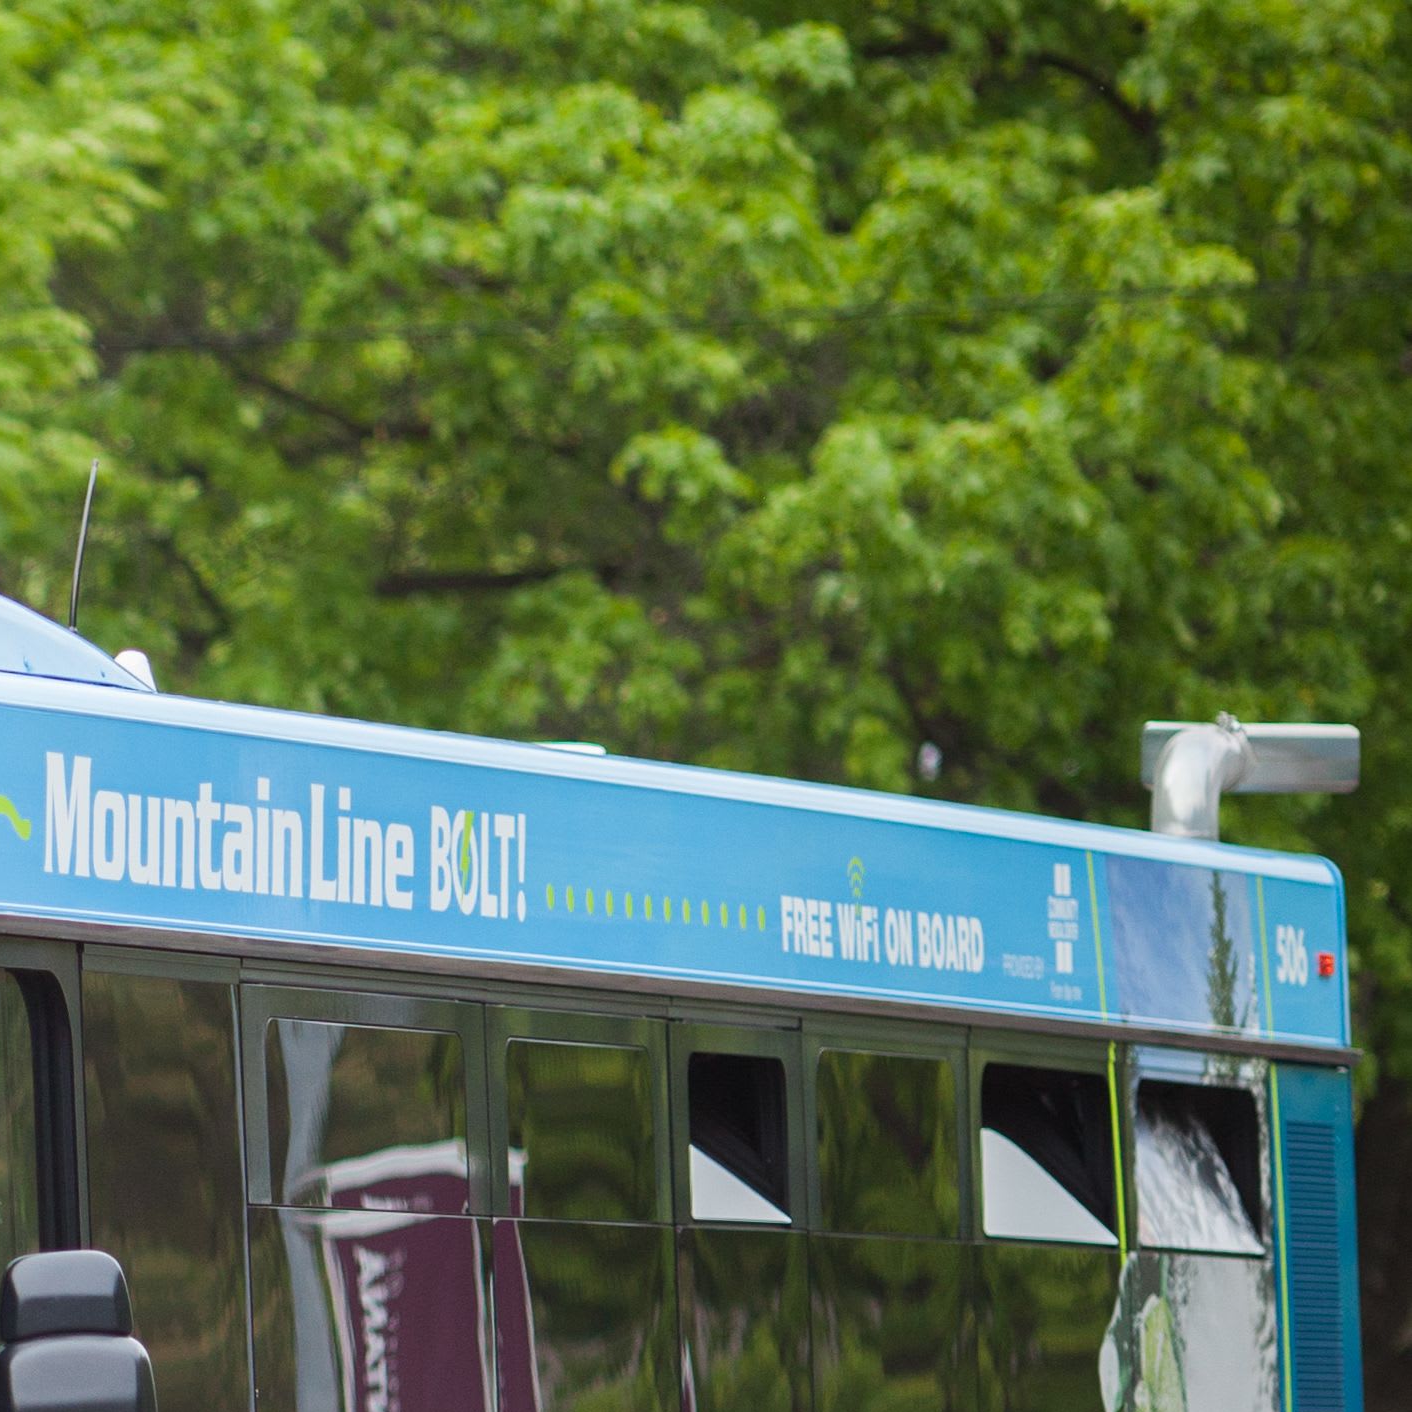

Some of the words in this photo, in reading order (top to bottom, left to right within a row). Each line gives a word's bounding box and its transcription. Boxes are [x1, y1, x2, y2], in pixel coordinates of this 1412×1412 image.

[429, 804, 528, 923] BOLT!
[780, 895, 834, 958] FREE
[836, 902, 880, 964] WiFi
[884, 907, 914, 966] ON
[917, 910, 985, 974] BOARD
[1276, 925, 1309, 987] 506
